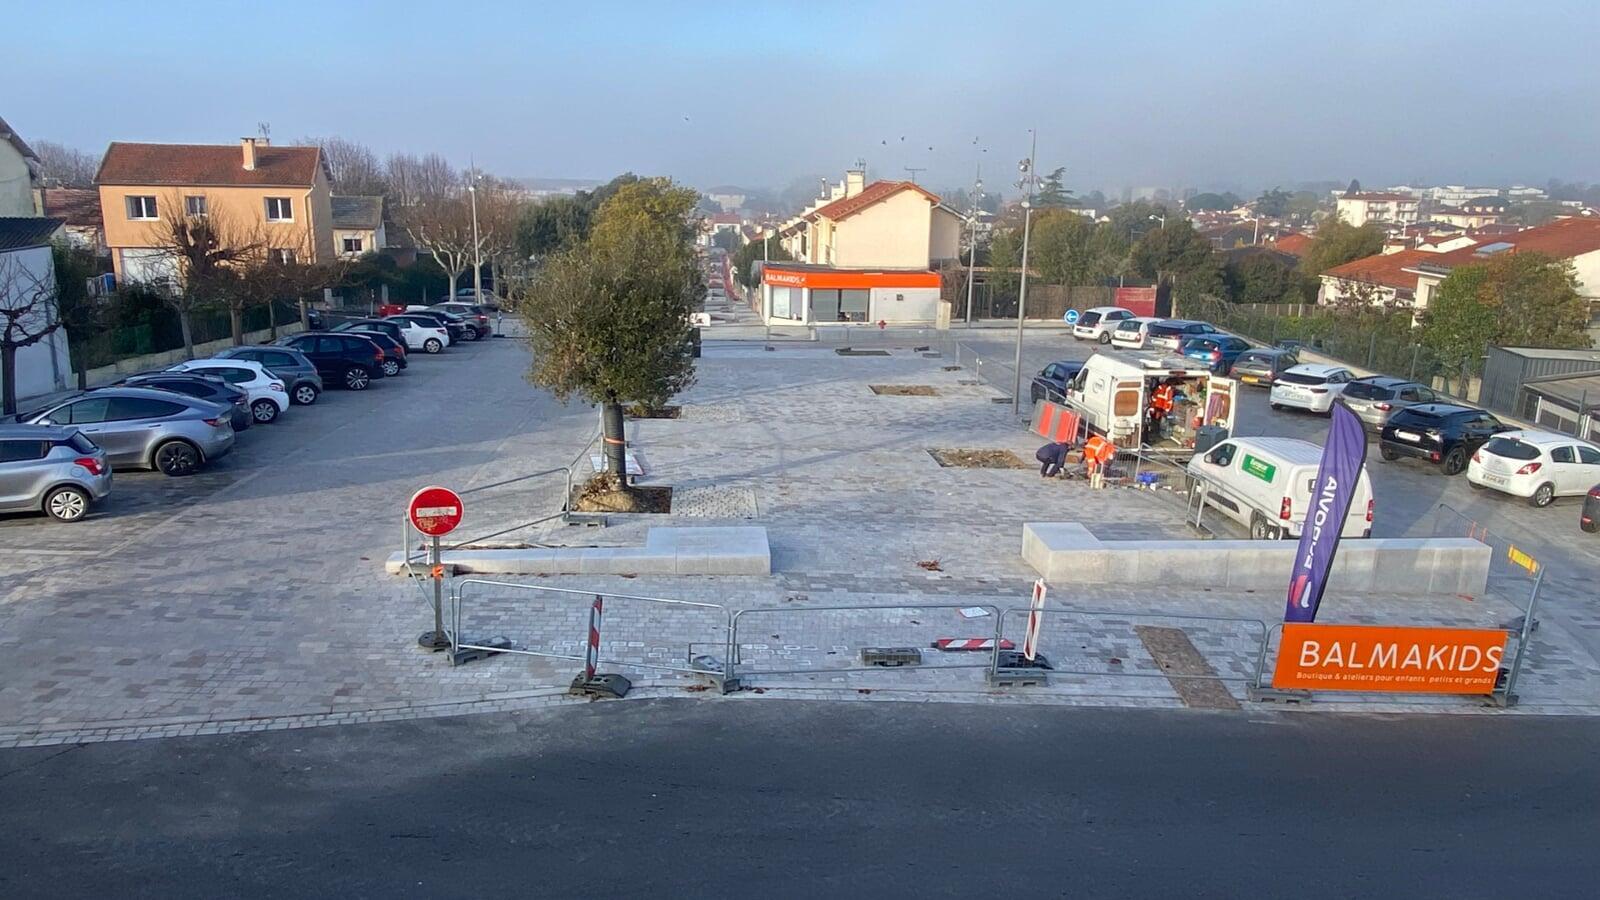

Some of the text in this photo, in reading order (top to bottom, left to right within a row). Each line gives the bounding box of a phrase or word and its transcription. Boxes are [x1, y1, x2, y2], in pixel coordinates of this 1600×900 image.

[1299, 640, 1503, 672] BALMAKIDS
[1296, 671, 1333, 681] Boutique
[1342, 673, 1374, 681] ateliers
[1375, 675, 1395, 683] pour
[1429, 675, 1453, 684] petits
[1454, 676, 1464, 684] et
[1464, 677, 1492, 685] grands
